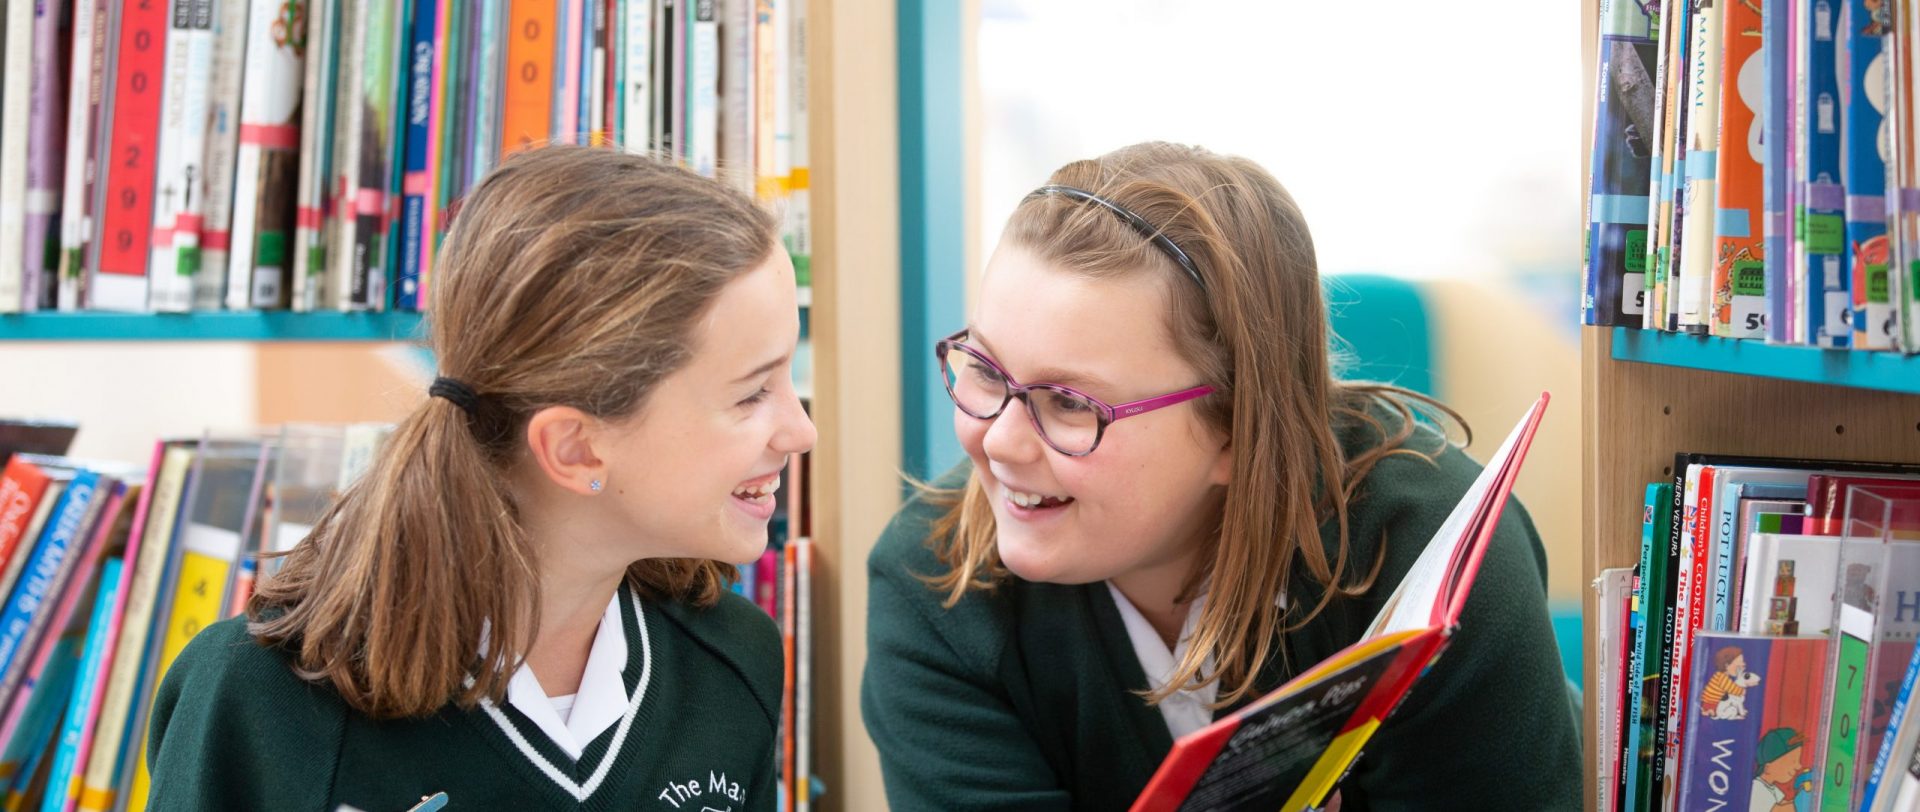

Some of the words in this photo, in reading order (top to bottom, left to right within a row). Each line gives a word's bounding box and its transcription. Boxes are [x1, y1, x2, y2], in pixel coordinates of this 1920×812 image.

[1674, 476, 1683, 506] PIERO
[1670, 509, 1681, 556] VENTURA
[1697, 497, 1708, 557] Children's
[1720, 511, 1732, 550] POT
[1639, 544, 1650, 605] Perspectives
[1679, 569, 1688, 601] The
[1715, 554, 1728, 605] LUCK
[1665, 606, 1674, 644] FOOD
[1671, 606, 1685, 669] Baking
[1634, 680, 1640, 689] of
[1659, 647, 1671, 717] THROUGH
[1669, 674, 1680, 718] Book
[1657, 719, 1666, 749] THE
[1621, 747, 1629, 785] Hamsters
[1655, 751, 1664, 782] AGES
[658, 779, 702, 808] The
